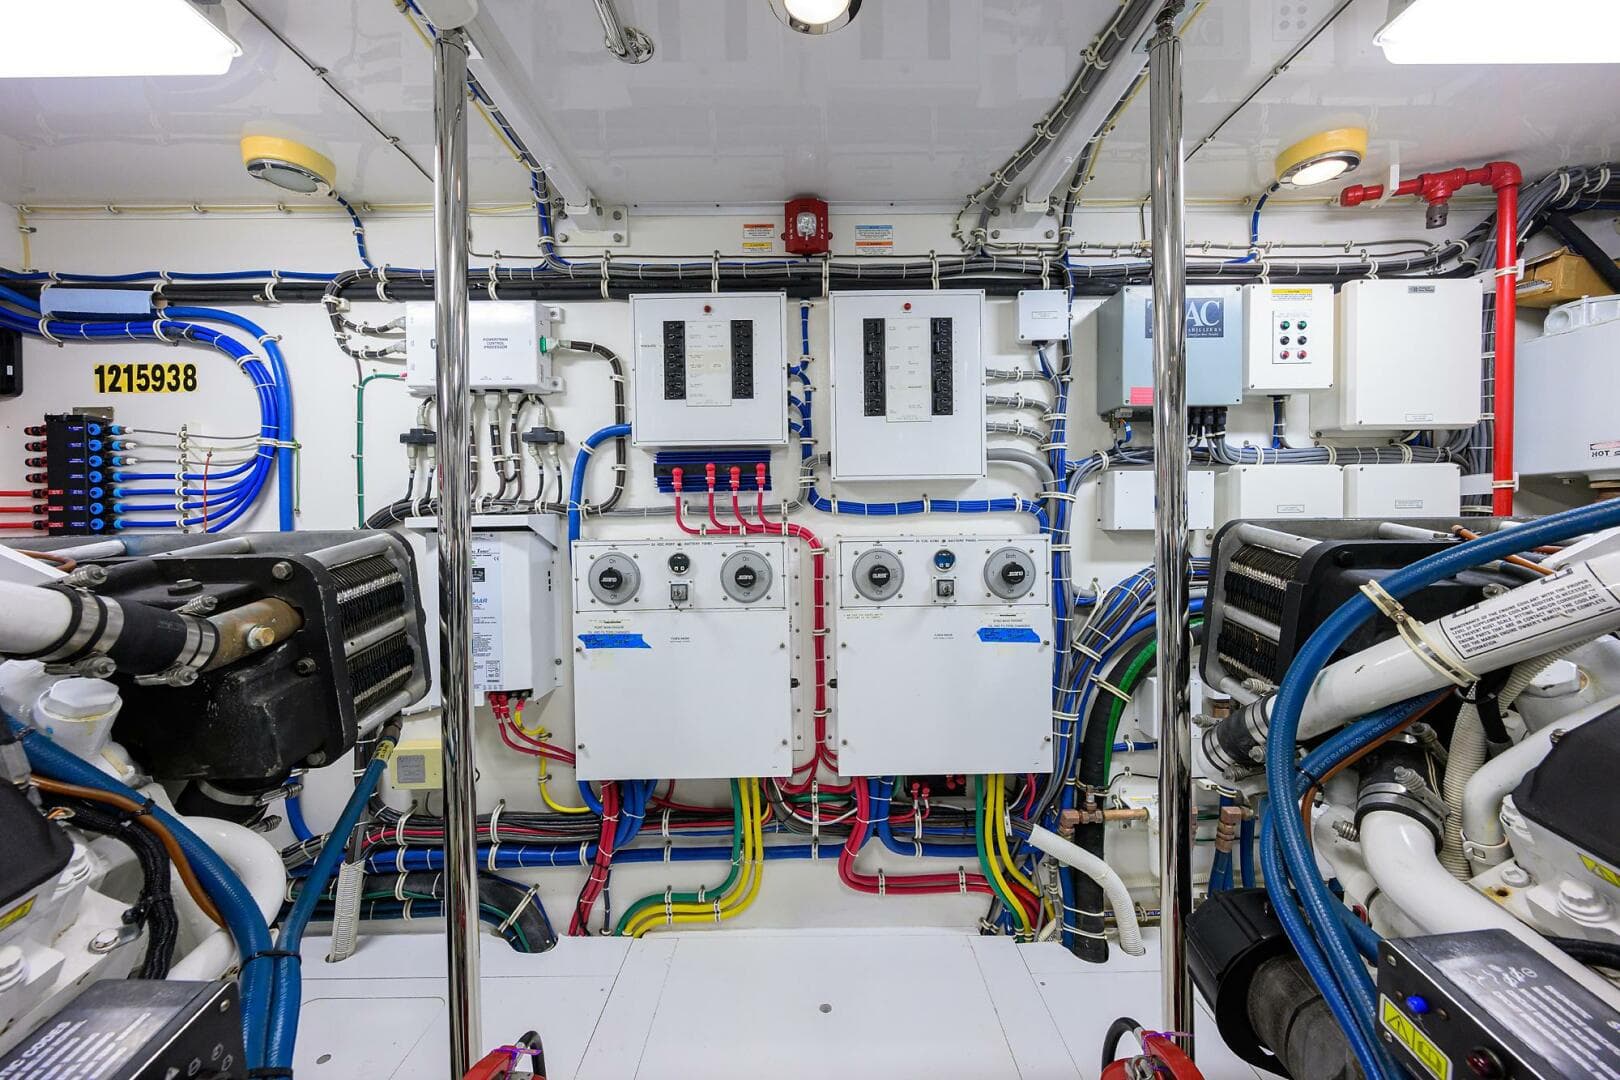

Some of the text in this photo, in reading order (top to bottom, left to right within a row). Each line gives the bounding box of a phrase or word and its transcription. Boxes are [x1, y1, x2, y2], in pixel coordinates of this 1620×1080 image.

[95, 364, 197, 393] 1215938
[1516, 596, 1540, 607] COOLANT
[1566, 579, 1589, 589] PROPER
[1508, 604, 1531, 615] COOLANT
[1522, 611, 1545, 622] CONTACT
